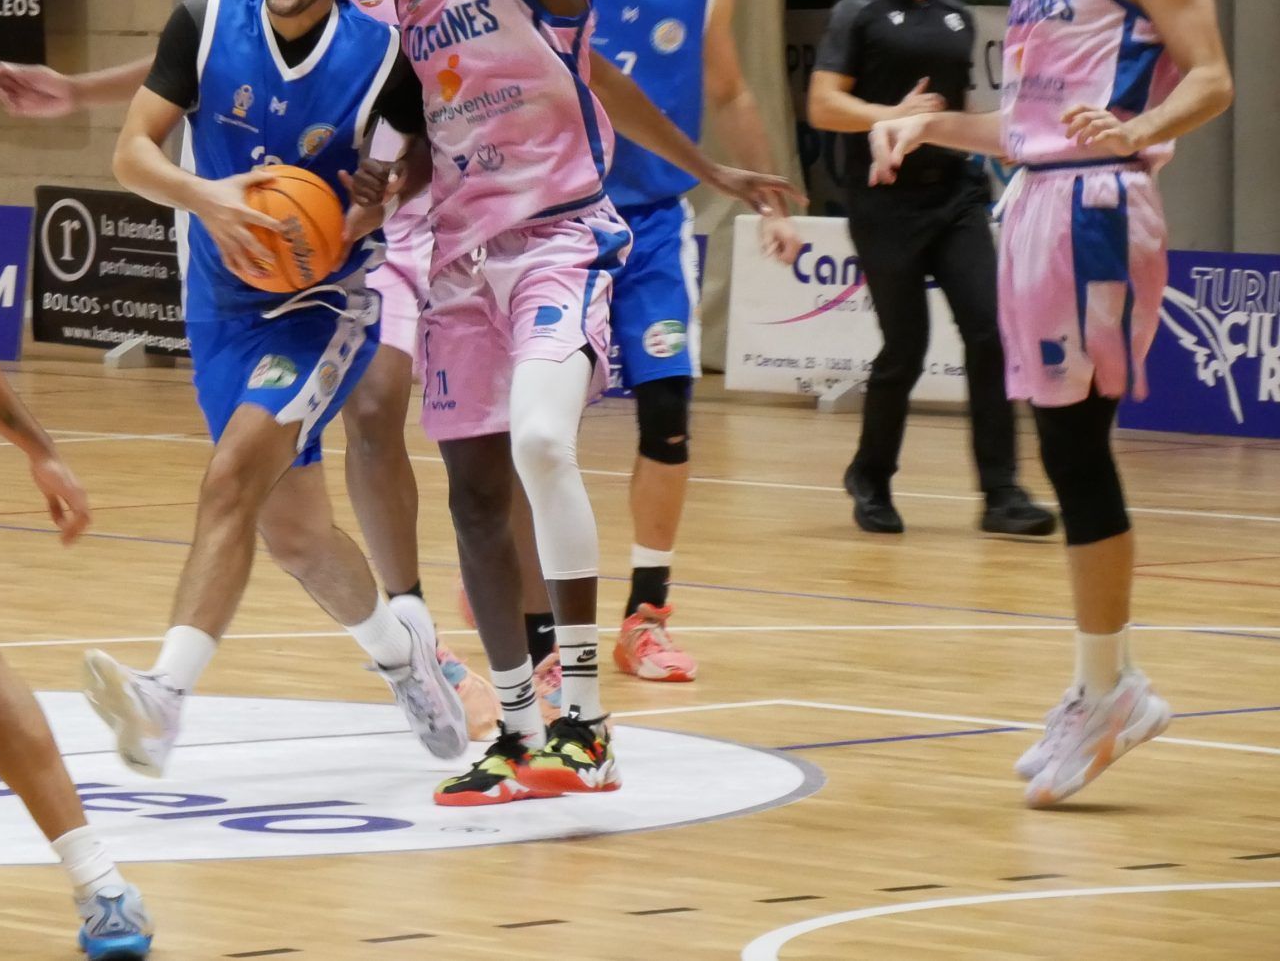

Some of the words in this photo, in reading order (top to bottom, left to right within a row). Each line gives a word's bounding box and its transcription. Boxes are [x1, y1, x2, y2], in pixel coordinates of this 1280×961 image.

[100, 214, 115, 236] la
[117, 217, 165, 241] tienda
[792, 242, 864, 285] Can
[42, 292, 101, 315] BOLSOS
[1190, 266, 1280, 315] TURI
[1219, 310, 1280, 359] CIU
[435, 369, 448, 396] 11
[431, 399, 457, 410] vive
